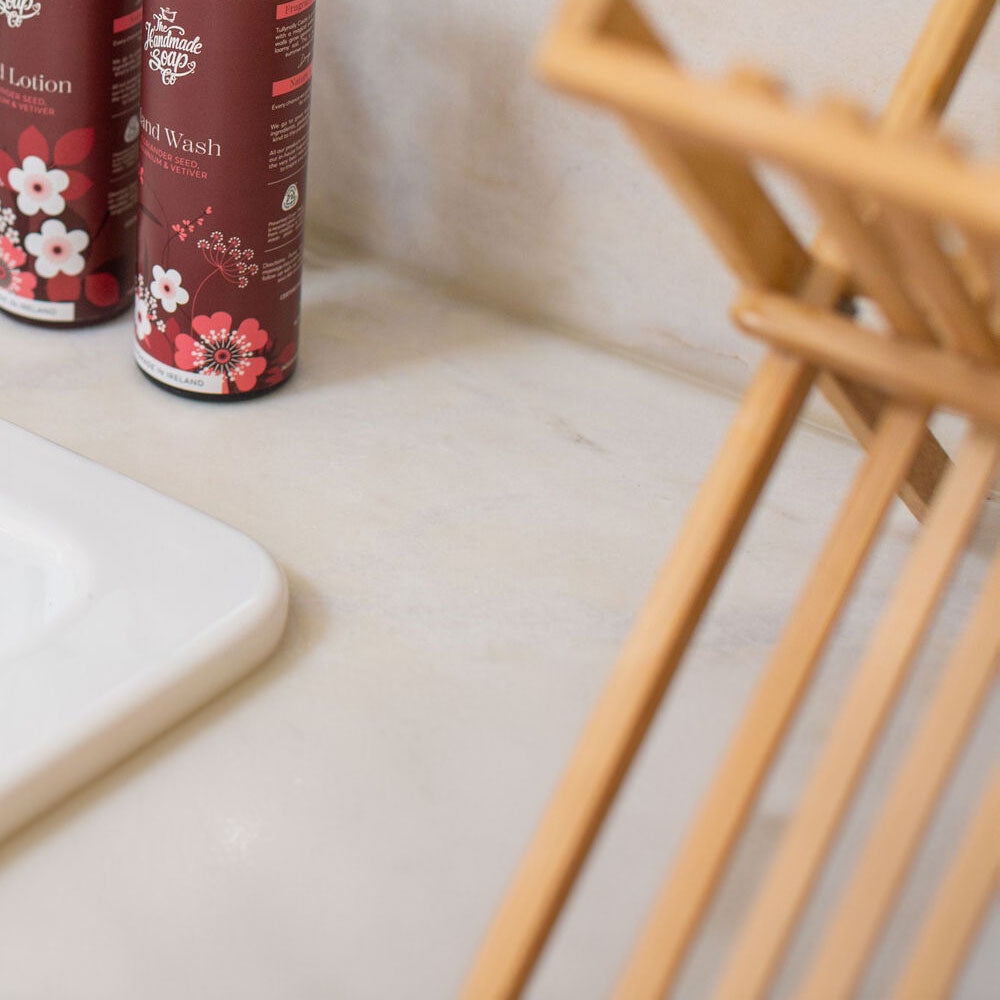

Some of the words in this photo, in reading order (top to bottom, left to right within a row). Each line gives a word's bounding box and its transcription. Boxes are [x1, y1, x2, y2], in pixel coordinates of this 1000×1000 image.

[144, 21, 203, 55] Handmade
[9, 66, 73, 94] Lotion
[165, 126, 221, 157] Wash
[170, 163, 208, 180] VETIVER
[174, 156, 200, 170] SEED,
[167, 371, 205, 387] IRELAND
